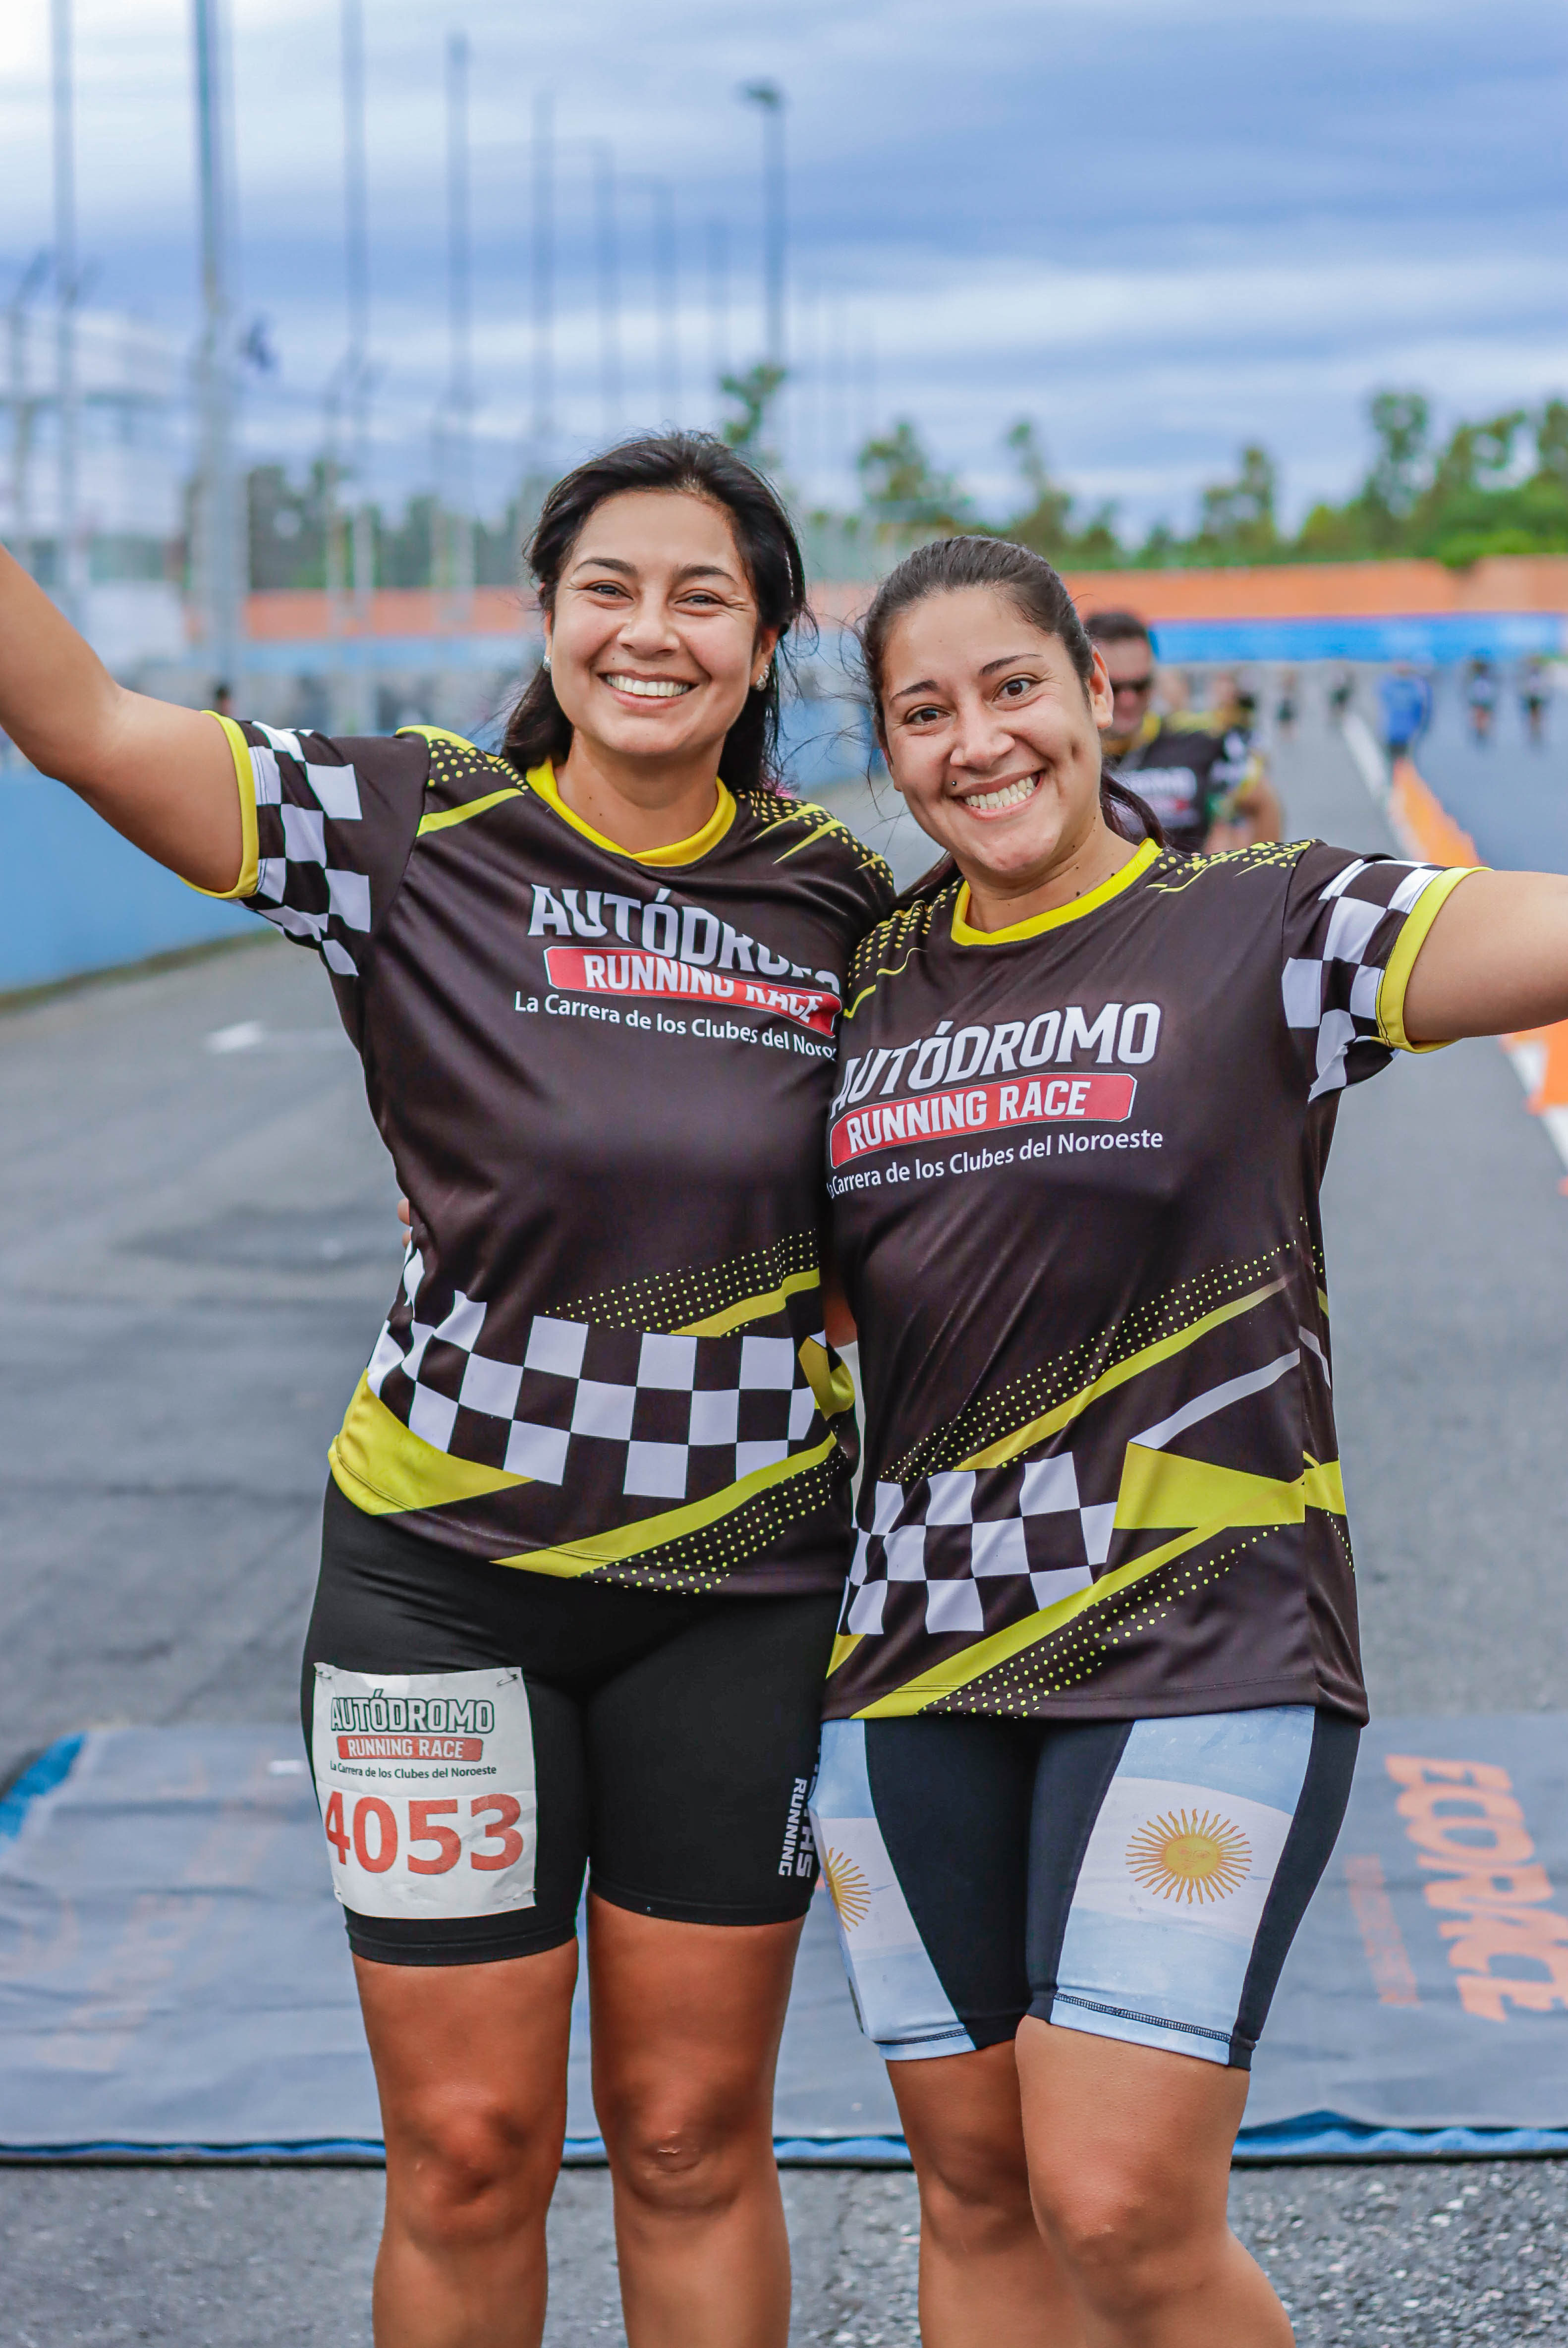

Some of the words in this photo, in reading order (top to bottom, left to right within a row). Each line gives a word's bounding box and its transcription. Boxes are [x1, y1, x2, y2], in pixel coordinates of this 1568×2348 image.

[528, 884, 840, 994] AUTÓDRO
[583, 954, 734, 997] RUNNING
[514, 991, 538, 1013] La
[545, 994, 620, 1024] Carrera
[625, 1009, 651, 1030] de
[657, 1013, 686, 1035] los
[692, 1018, 758, 1044] Clubes
[762, 1028, 789, 1050] del
[830, 1003, 1161, 1119] AUTÓDROMO
[846, 1091, 988, 1154] RUNNING
[998, 1080, 1091, 1121] RACE
[832, 1170, 881, 1195] Carrera
[886, 1162, 910, 1183] de
[916, 1158, 944, 1179] los
[950, 1148, 1014, 1174] Clubes
[1019, 1135, 1051, 1161] del
[1058, 1129, 1163, 1155] Noroeste
[331, 1688, 495, 1734] AUTÓDROMO
[330, 1760, 336, 1771] La
[337, 1762, 363, 1776] Carrera
[365, 1767, 376, 1777] de
[379, 1767, 392, 1778] los
[394, 1768, 429, 1778] Clubes
[432, 1768, 448, 1778] del
[451, 1766, 497, 1777] Noroeste
[348, 1738, 413, 1757] RUNNING
[418, 1739, 464, 1758] RACE
[325, 1791, 523, 1875] 4053
[778, 1778, 807, 1877] RUNNING
